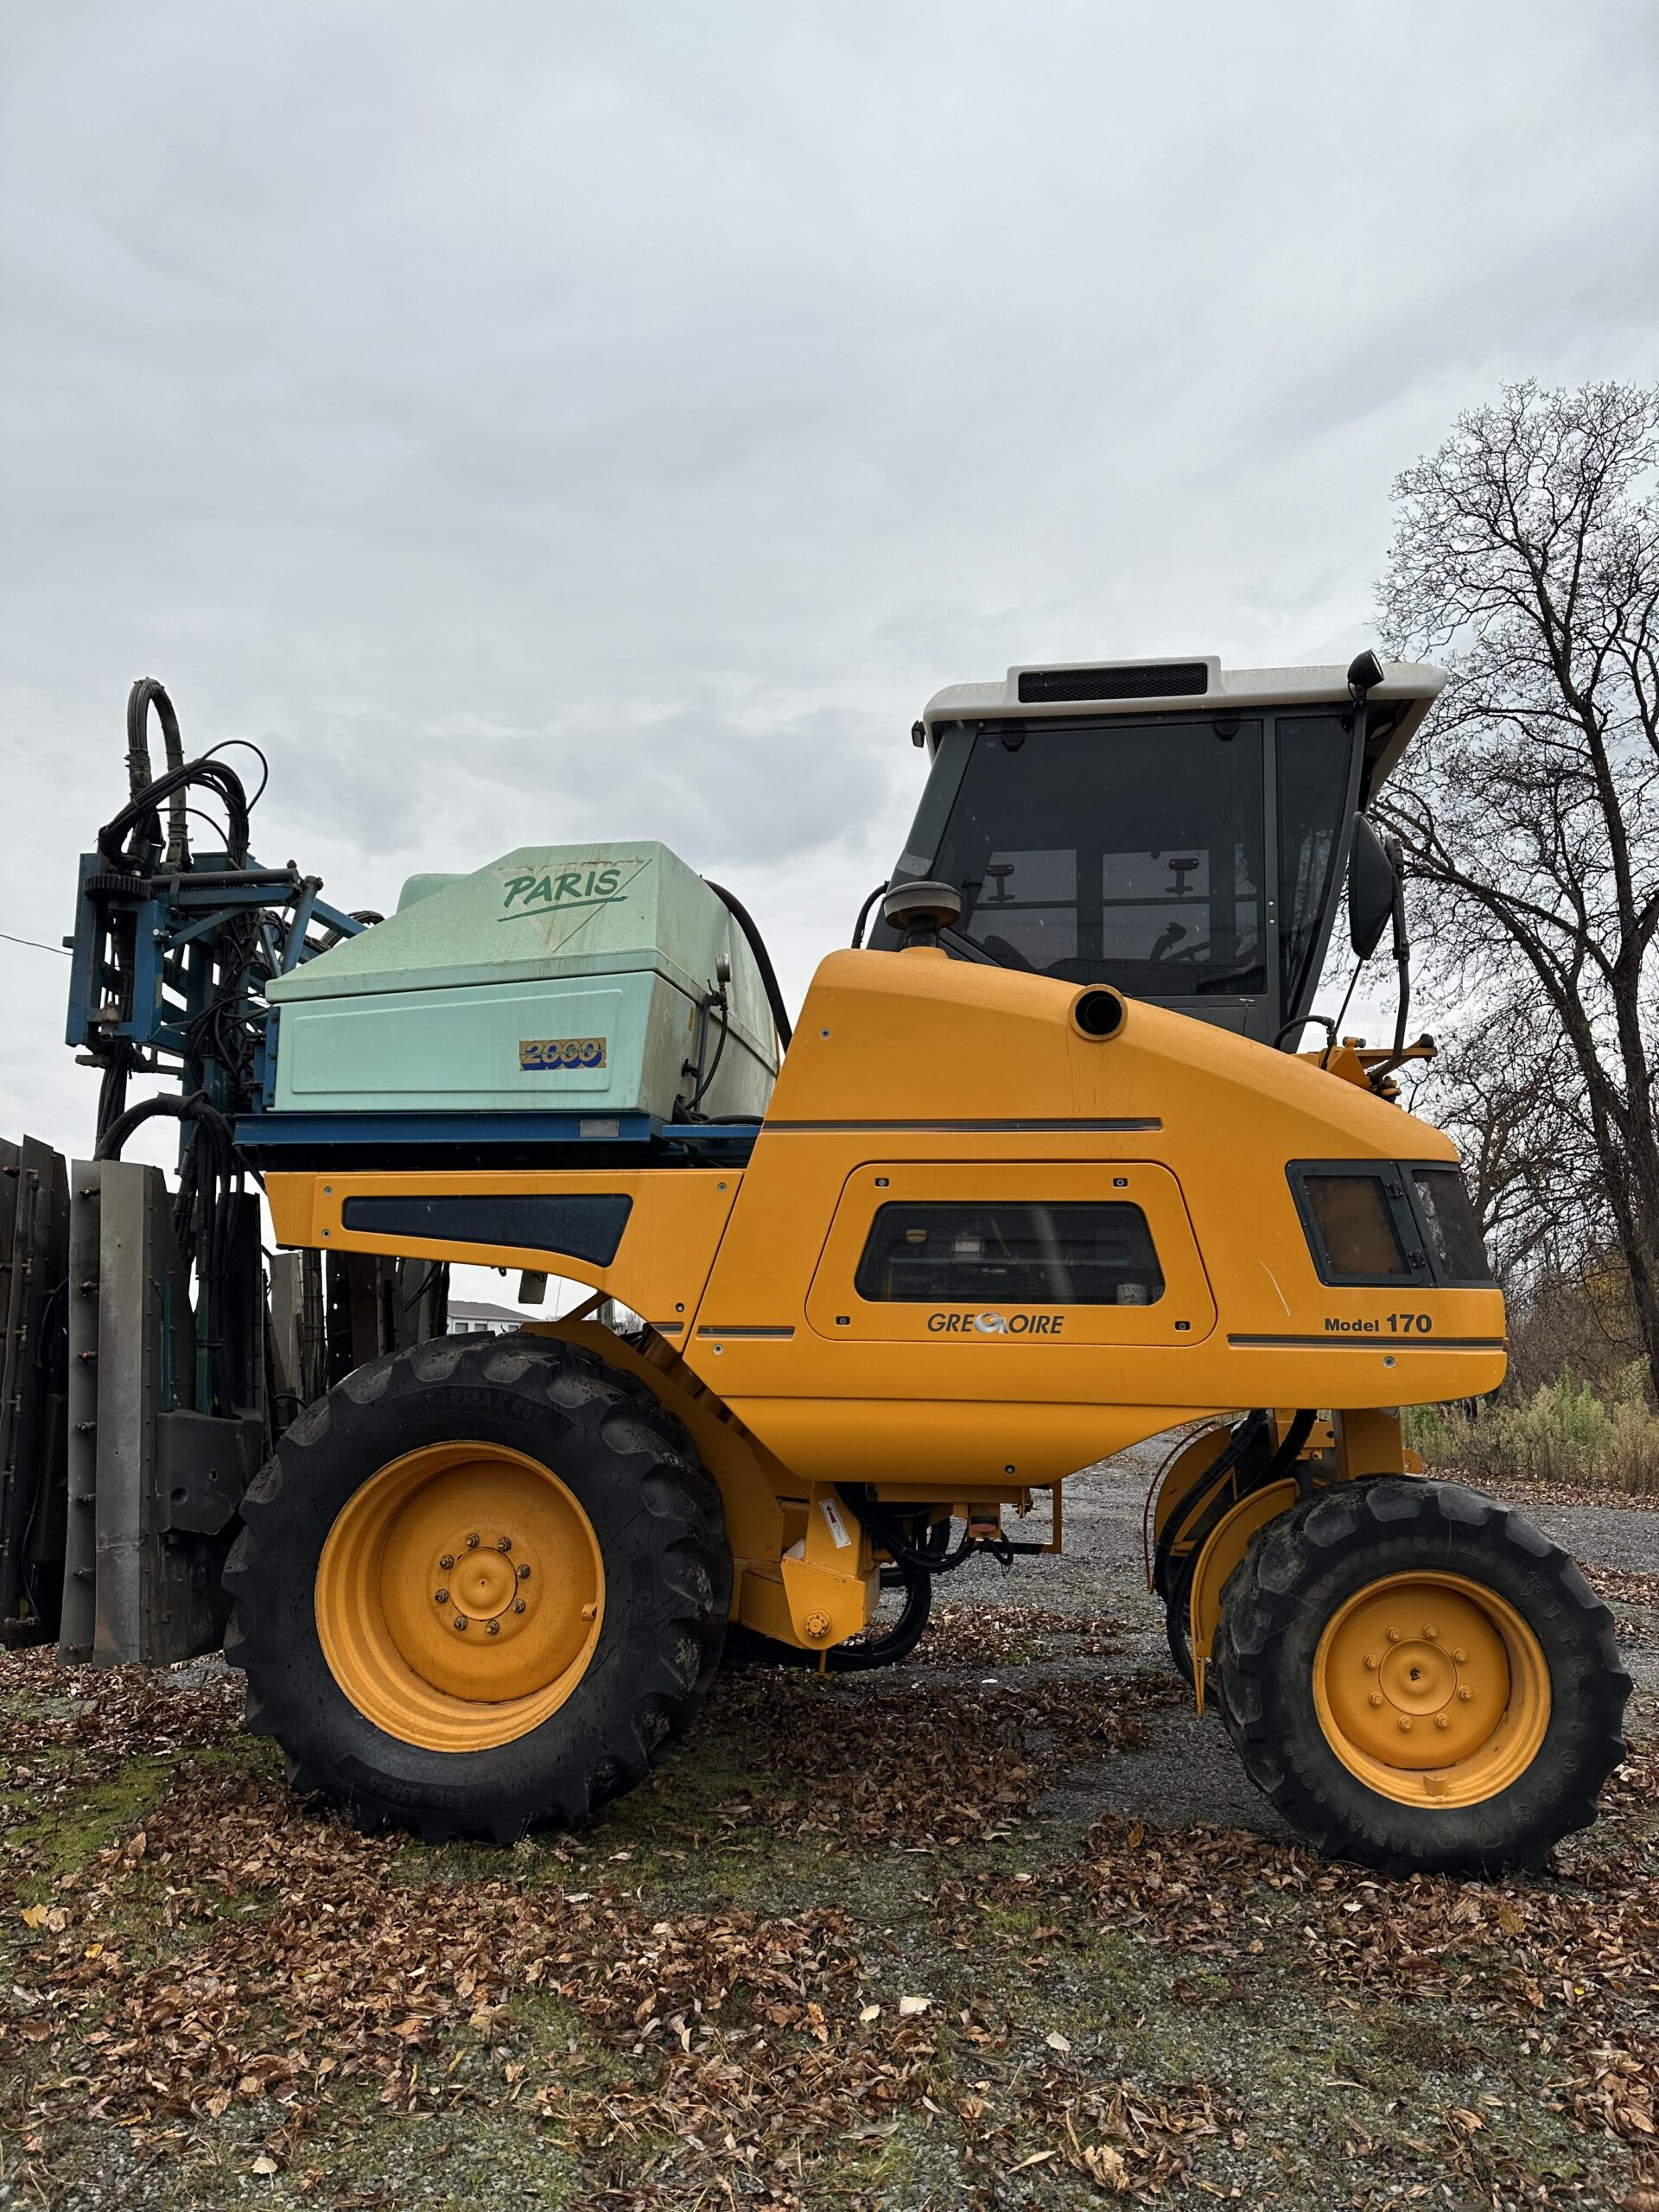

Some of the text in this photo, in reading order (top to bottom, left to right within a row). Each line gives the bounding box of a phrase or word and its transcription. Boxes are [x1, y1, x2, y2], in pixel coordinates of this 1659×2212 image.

[503, 868, 622, 908] PARIS
[521, 1039, 602, 1071] 2000
[927, 1312, 1065, 1335] GREGOIRE
[1325, 1313, 1433, 1333] Model 170
[1338, 1808, 1424, 1858] RADIAL
